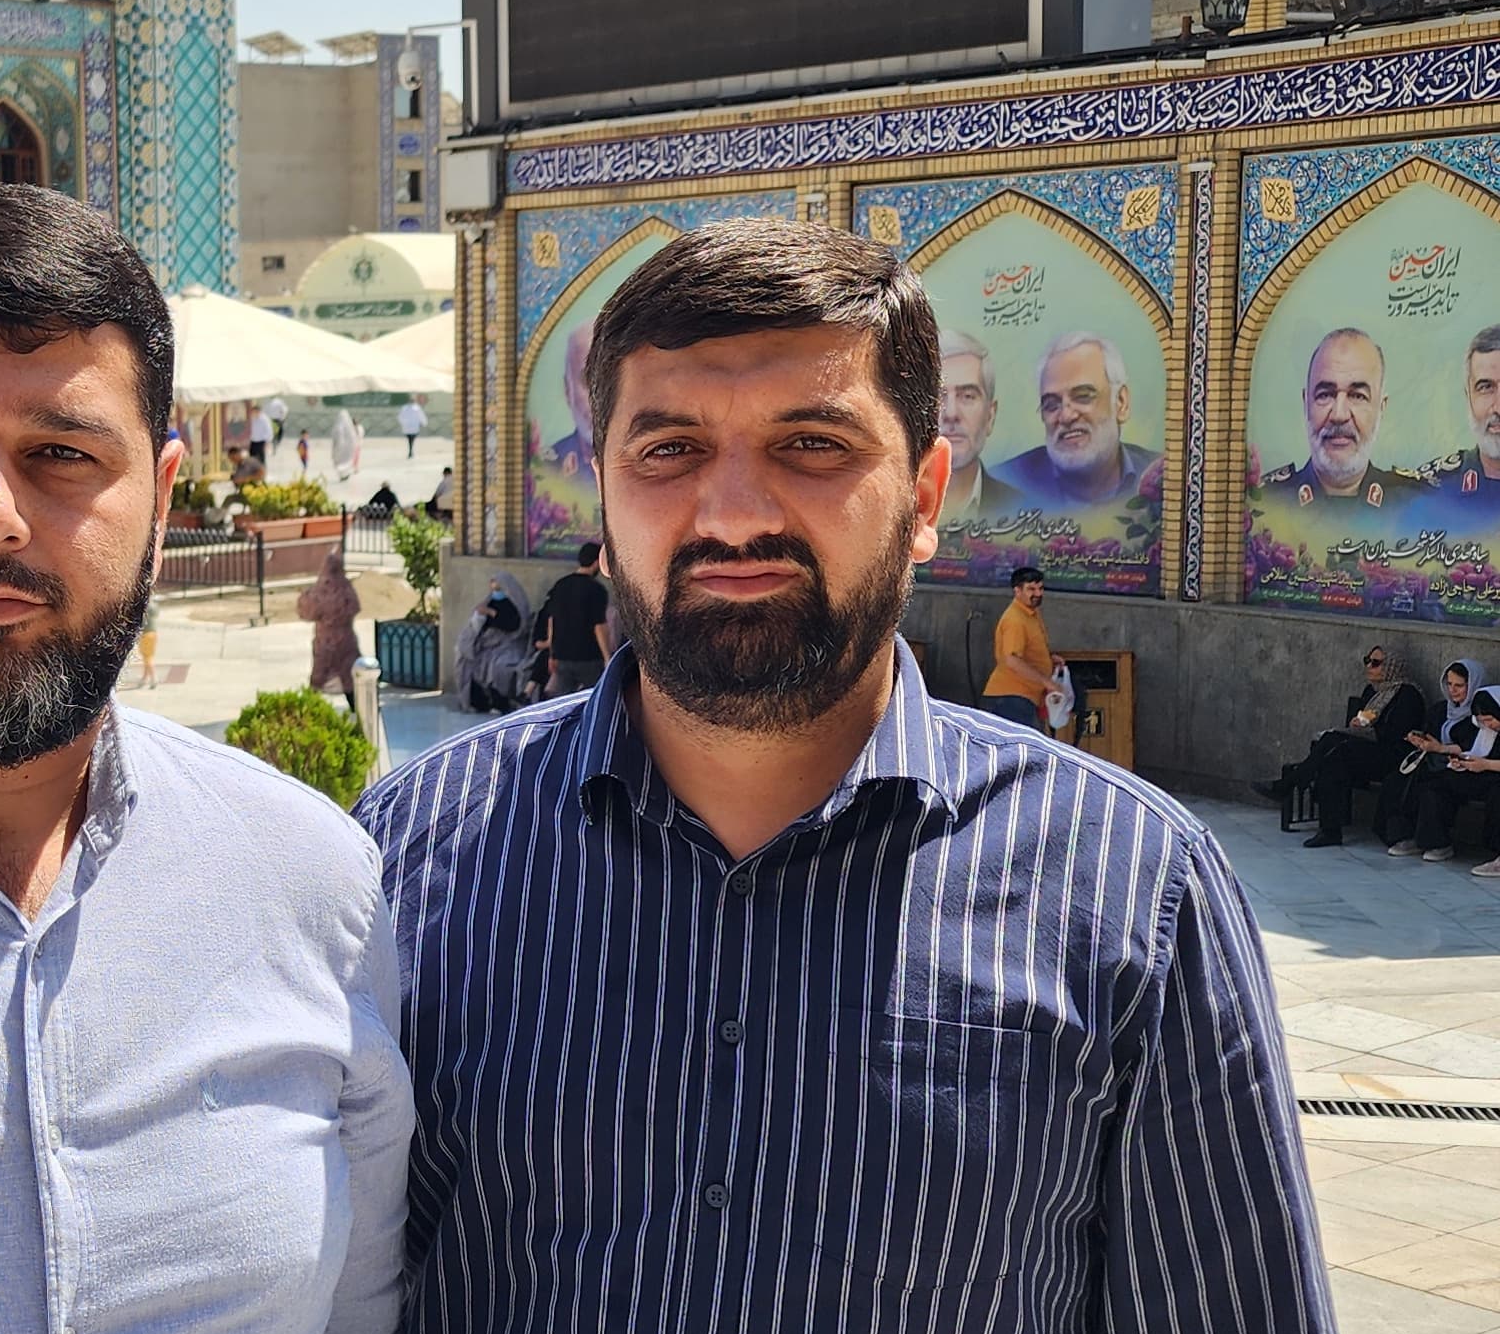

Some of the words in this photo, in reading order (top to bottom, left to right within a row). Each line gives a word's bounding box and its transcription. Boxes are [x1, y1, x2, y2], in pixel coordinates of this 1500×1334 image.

[1388, 245, 1445, 282] حسین
[1422, 247, 1461, 279] ایران
[983, 265, 1031, 296] حسین
[1012, 266, 1045, 294] ایران
